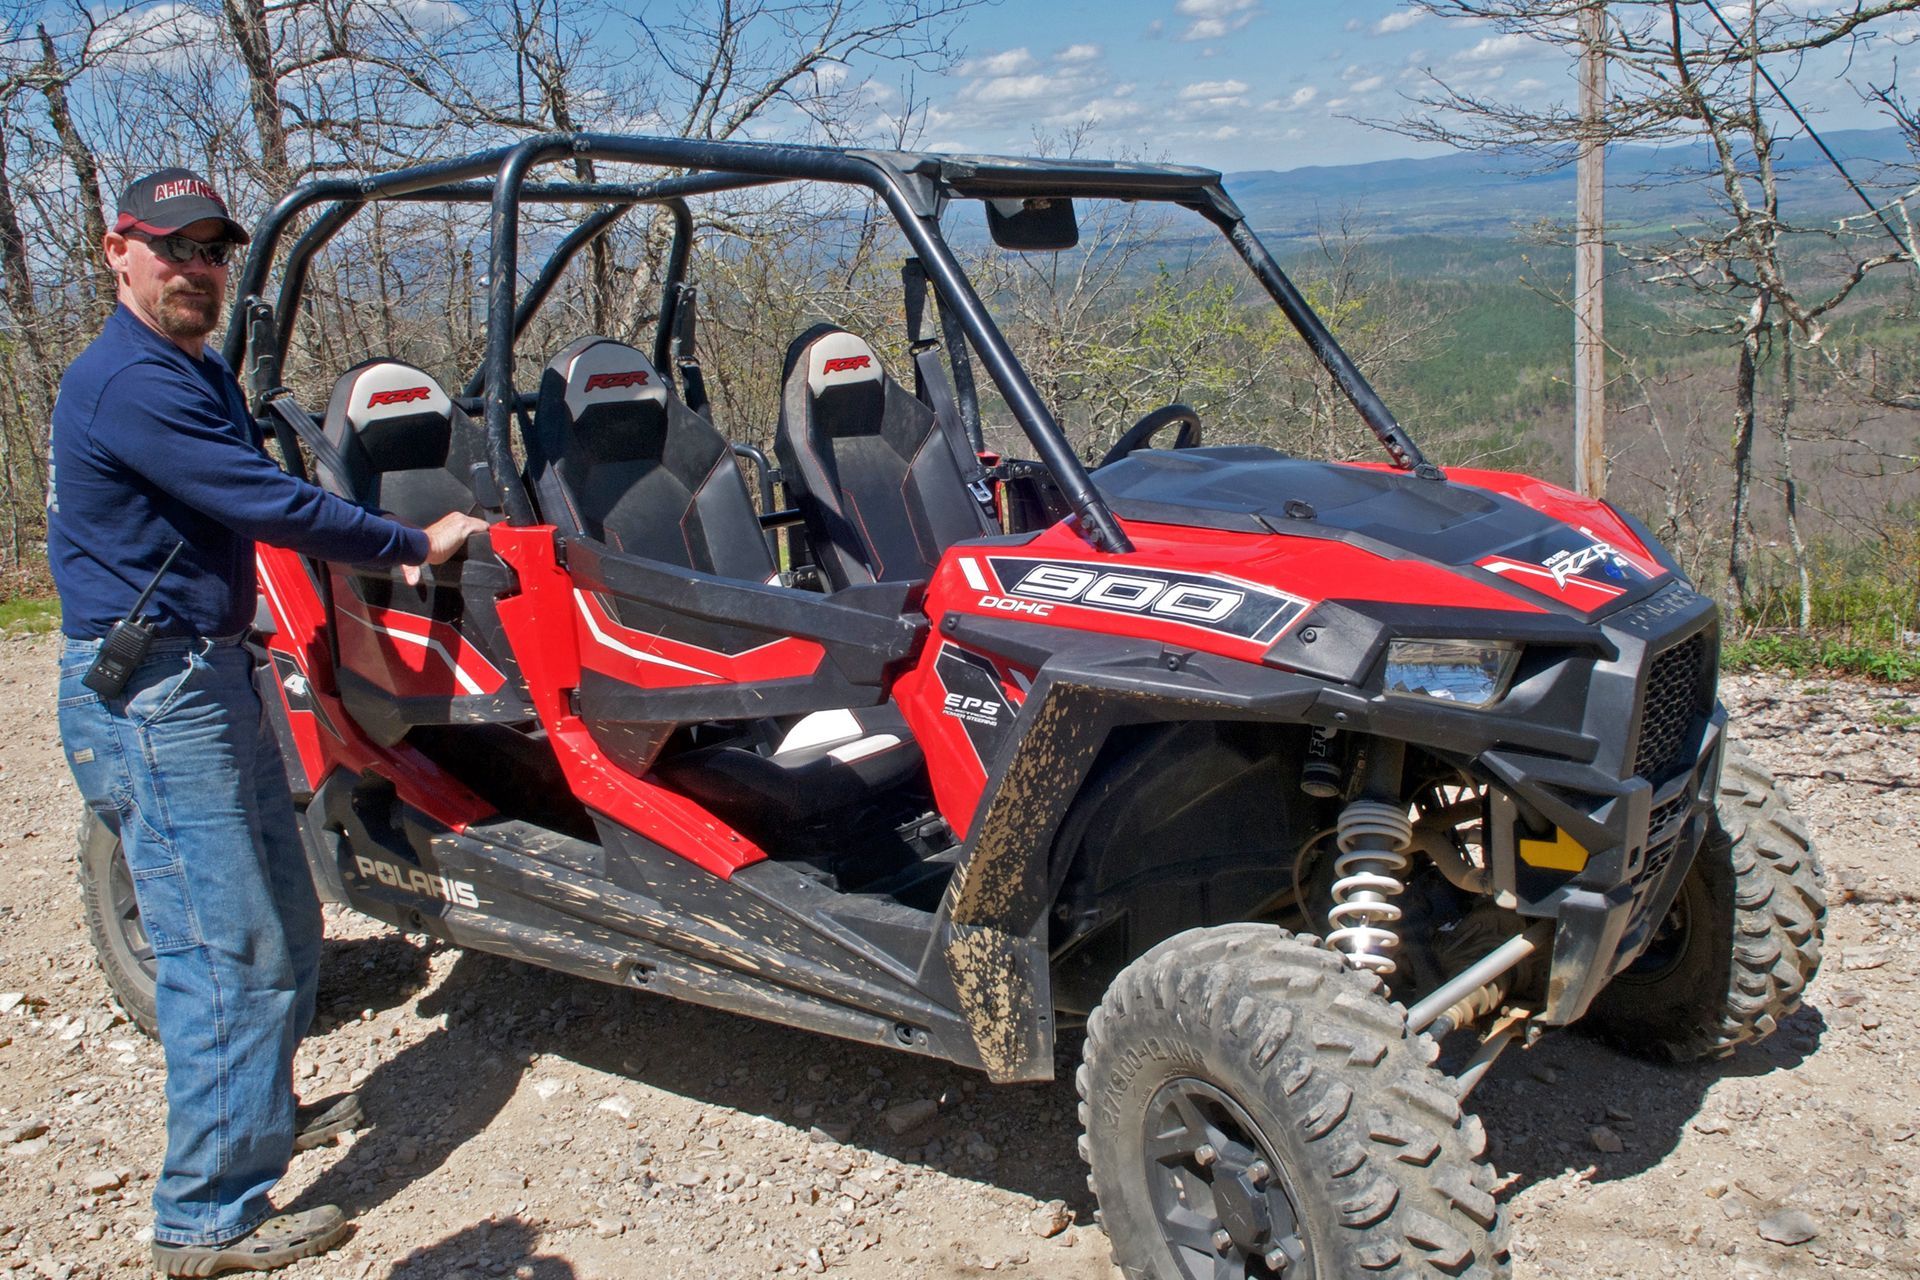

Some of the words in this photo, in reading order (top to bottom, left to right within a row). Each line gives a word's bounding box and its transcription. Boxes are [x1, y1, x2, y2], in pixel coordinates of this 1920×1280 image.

[822, 354, 871, 375] RZR
[584, 370, 648, 392] RZR
[366, 386, 431, 409] RZR
[1550, 542, 1619, 591] RZR
[1012, 565, 1243, 622] 900
[978, 595, 1056, 617] DOHC
[282, 671, 306, 695] 4
[944, 693, 1001, 715] EPS
[966, 715, 998, 726] STEERING
[355, 855, 479, 908] POLARIS
